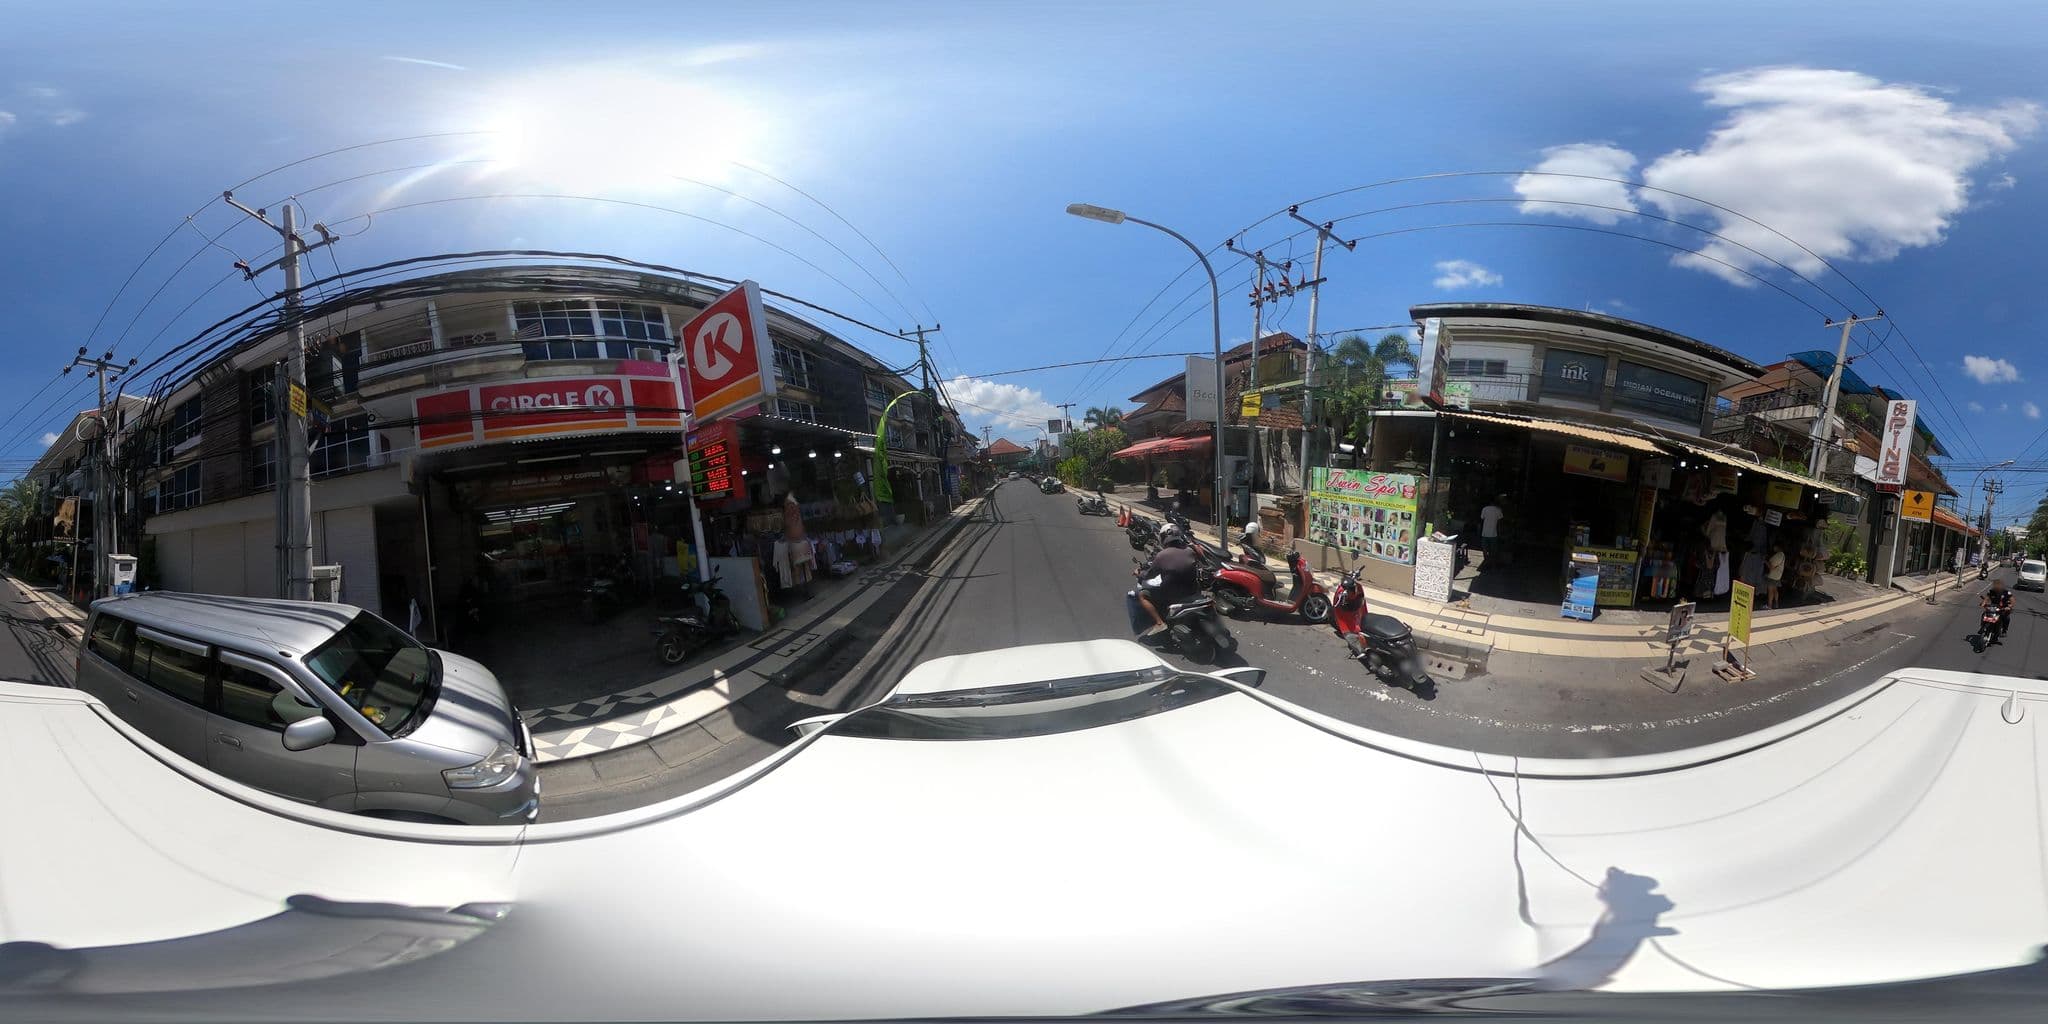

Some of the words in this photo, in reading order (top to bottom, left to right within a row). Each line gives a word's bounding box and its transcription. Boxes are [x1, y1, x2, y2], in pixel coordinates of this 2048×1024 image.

[702, 319, 741, 369] K
[1560, 364, 1590, 381] ink
[491, 391, 579, 410] CIRCLE
[1623, 379, 1652, 393] INDIAN
[1653, 387, 1682, 400] OCEAN
[1682, 394, 1697, 405] INK
[1364, 475, 1398, 498] Spa
[1609, 551, 1630, 560] HERE
